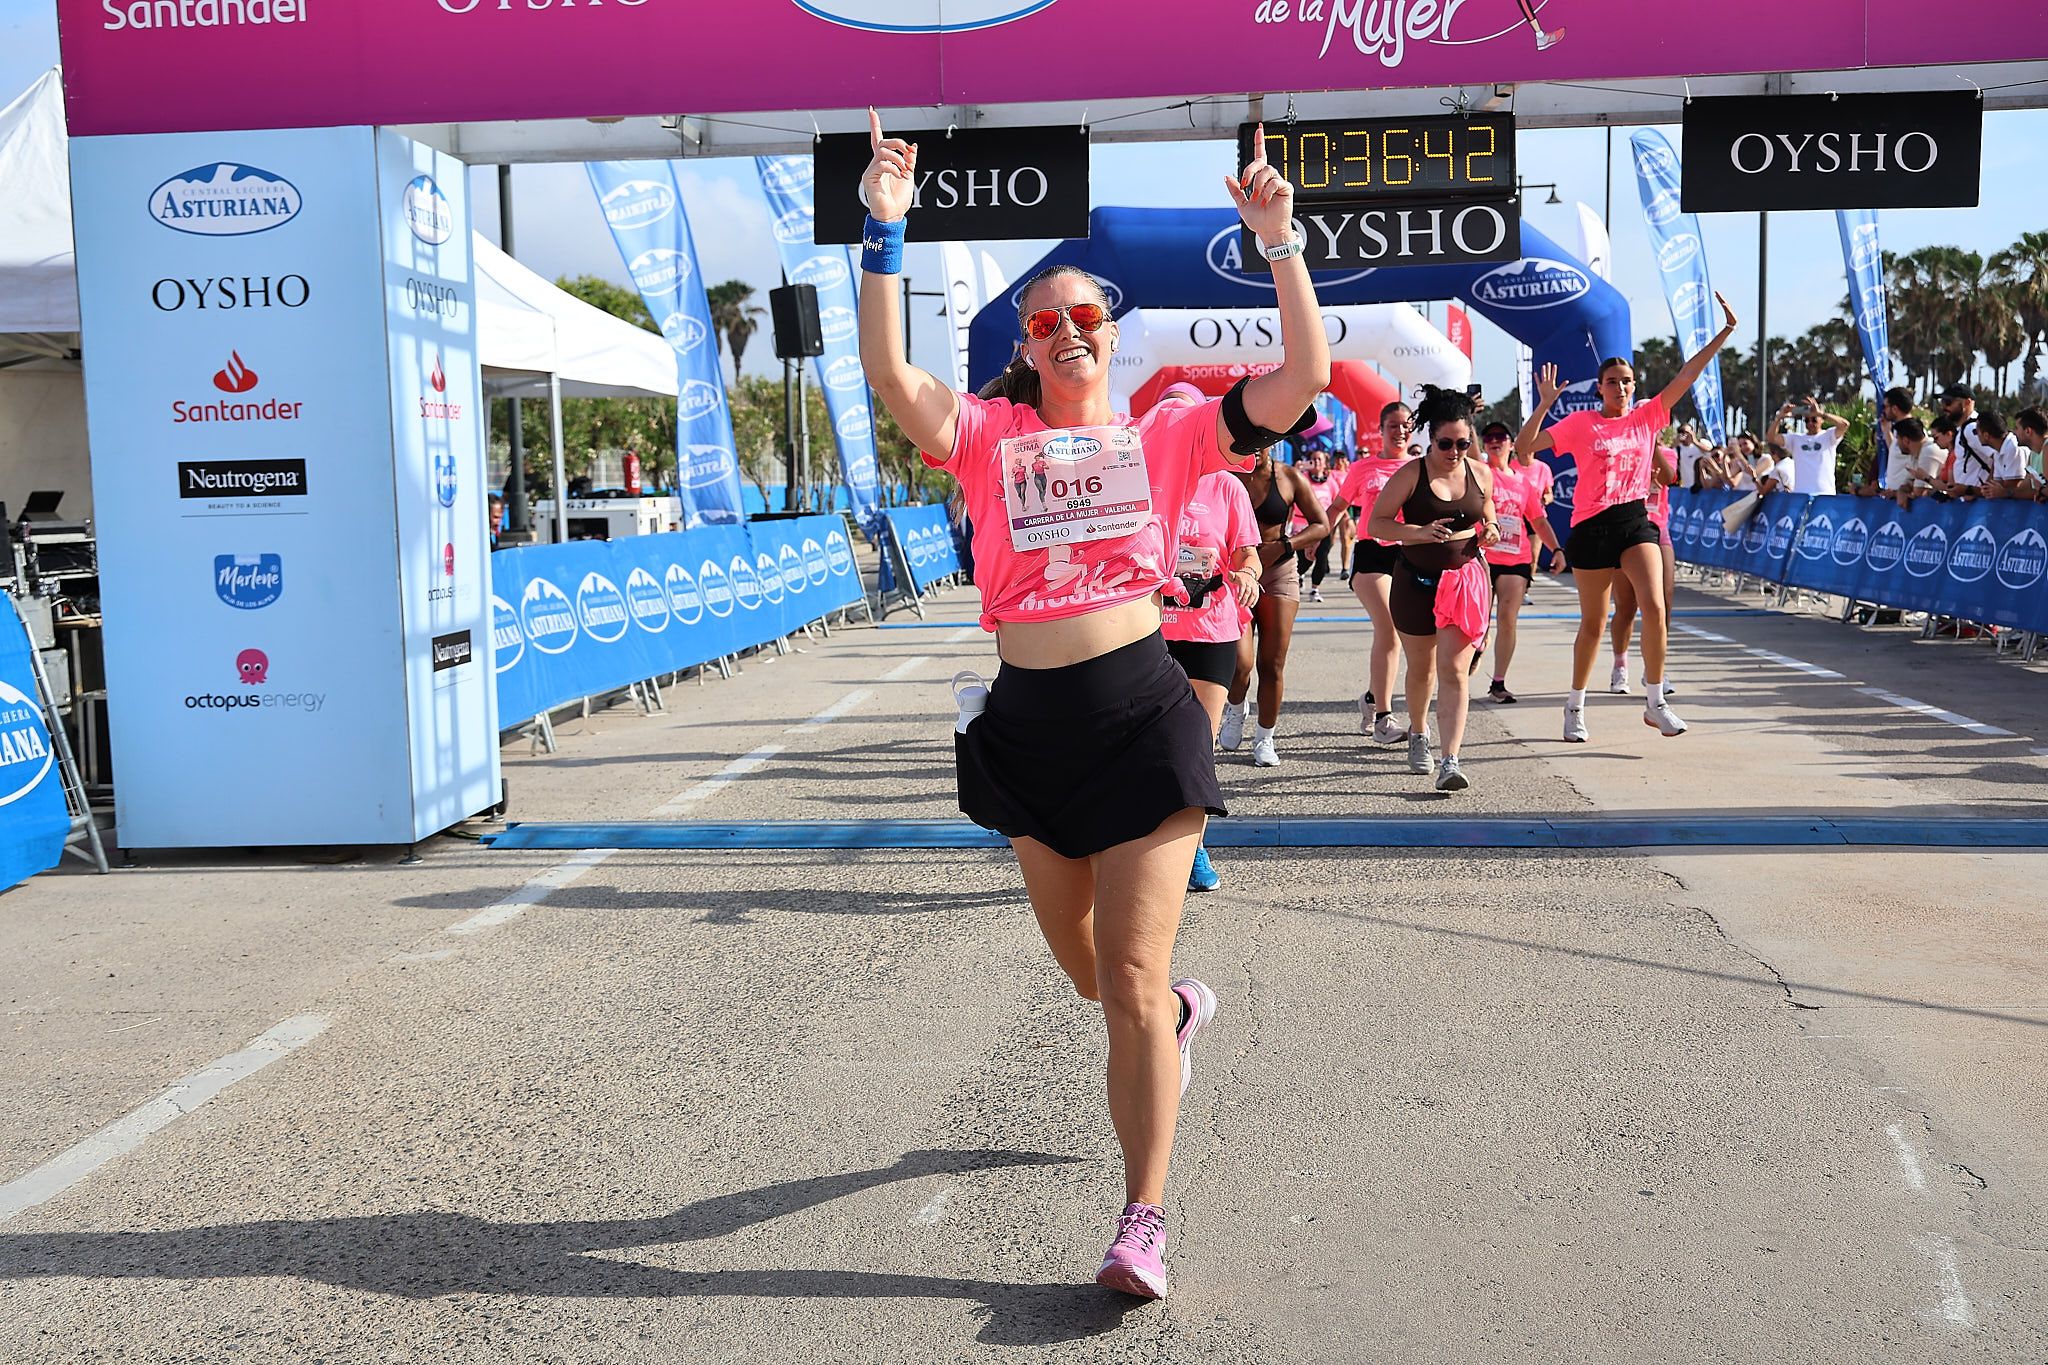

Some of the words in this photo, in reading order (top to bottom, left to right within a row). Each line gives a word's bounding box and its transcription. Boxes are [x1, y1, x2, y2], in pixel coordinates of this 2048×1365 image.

[1254, 0, 1290, 23] de
[1299, 0, 1324, 22] la
[1730, 132, 1938, 173] OYSHO
[182, 188, 230, 196] CENTRAL
[236, 186, 285, 194] LECHERA
[160, 192, 291, 219] ASTURIANA
[152, 274, 310, 311] OYSHO
[407, 278, 457, 317] OYSHO
[1481, 278, 1583, 300] ASTURIANA
[1189, 314, 1347, 349] OYSO
[1108, 356, 1143, 367] SHO
[1393, 345, 1441, 358] OYSHO
[1183, 364, 1227, 379] Sports
[173, 398, 303, 422] Santander
[1015, 443, 1039, 453] SUMA
[1048, 445, 1097, 455] ASTURIANA
[187, 469, 298, 492] Neutrogena
[1051, 476, 1103, 498] 016
[1024, 516, 1054, 526] CARRERA
[1076, 509, 1099, 518] MUJER
[1104, 503, 1137, 513] VALENCIA
[1067, 499, 1091, 509] 6949
[1028, 527, 1070, 542] OYSHO
[1097, 521, 1138, 532] Santander
[218, 566, 279, 595] Marlene
[1161, 613, 1177, 623] 026
[185, 693, 260, 712] octopus
[262, 692, 326, 712] energy
[0, 708, 30, 724] HERA
